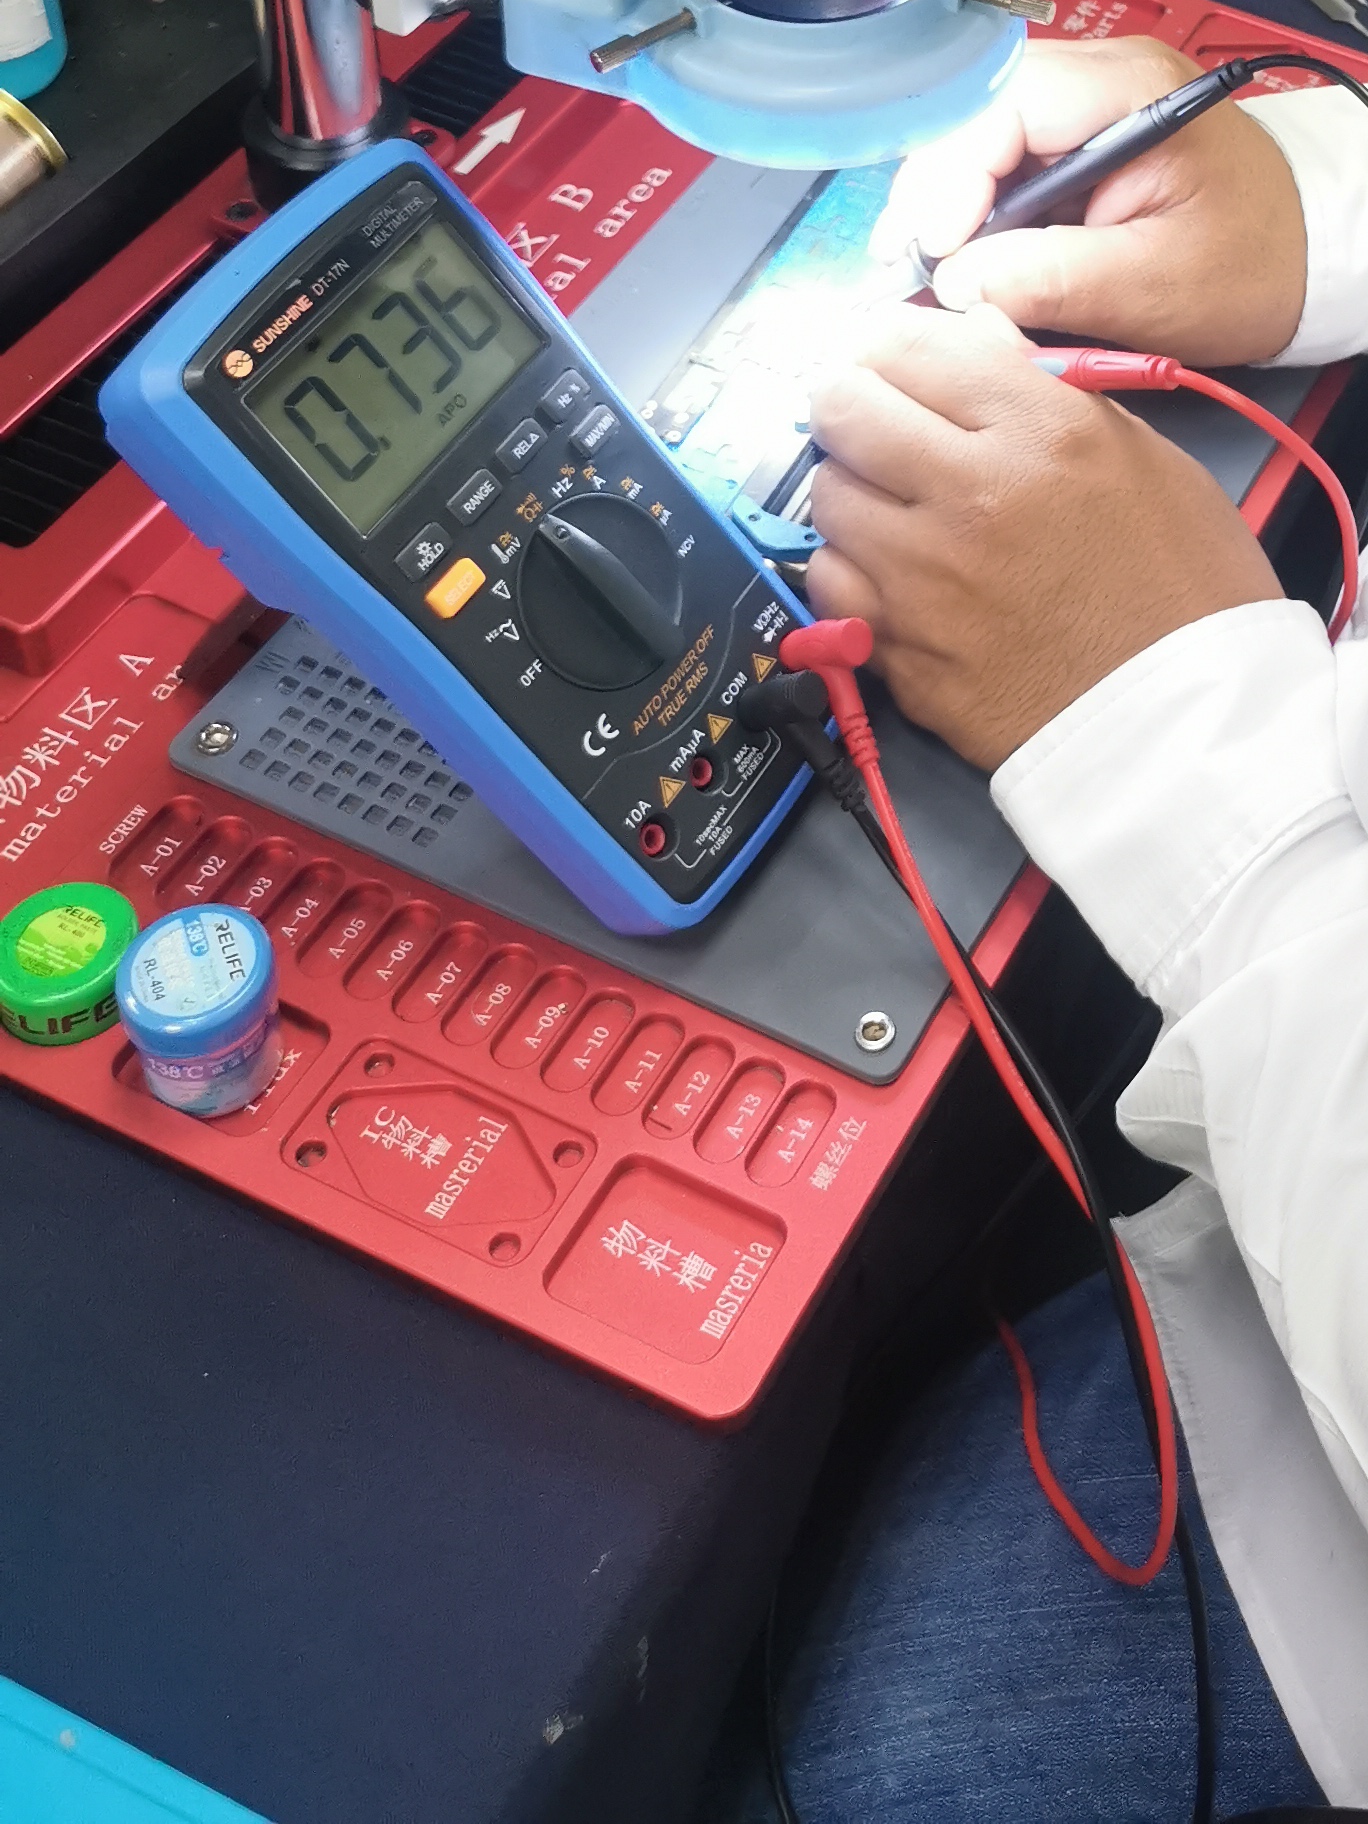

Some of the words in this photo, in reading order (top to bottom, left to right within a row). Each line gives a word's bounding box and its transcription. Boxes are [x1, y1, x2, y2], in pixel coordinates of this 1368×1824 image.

[547, 183, 594, 213] B
[593, 167, 673, 238] area
[361, 202, 398, 237] DIGITAL
[368, 196, 425, 250] MULTIMETER
[252, 293, 314, 354] SUNSHINE
[310, 258, 351, 297] DT-17N
[283, 256, 501, 482] 0.736
[437, 393, 468, 427] APO
[462, 479, 496, 514] RANGE
[551, 477, 575, 498] Hz
[592, 475, 607, 490] A
[627, 482, 644, 500] mA
[417, 542, 445, 572] HOLD
[505, 537, 522, 559] mV
[678, 534, 697, 558] NCV
[444, 570, 476, 606] SELECT
[485, 630, 500, 643] Hz
[118, 653, 156, 677] A
[520, 658, 545, 688] OFF
[631, 695, 664, 737] AUTO
[661, 648, 699, 697] POWER
[696, 623, 716, 654] OFF
[657, 693, 688, 728] TRUE
[684, 661, 710, 694] RMS
[721, 671, 749, 706] COM
[1, 716, 145, 863] material
[151, 664, 186, 702] ar
[733, 743, 751, 766] MAX
[741, 752, 766, 782] FUSED
[98, 803, 149, 856] SCREW
[624, 799, 652, 830] 10A
[707, 826, 723, 843] 10A
[140, 835, 184, 877] A-01
[708, 825, 734, 856] FUSED
[184, 854, 228, 896] A-02
[63, 904, 105, 929] RELIFE
[280, 897, 320, 939] A-04
[214, 918, 247, 982] RELIFE
[327, 917, 367, 960] A-05
[143, 957, 166, 1002] RL-404
[375, 939, 415, 982] A-06
[424, 961, 462, 1006] A-07
[474, 982, 512, 1027] A-08
[0, 994, 119, 1036] ELIFE
[524, 1004, 563, 1049] A-09
[572, 1026, 610, 1071] A-10
[624, 1049, 662, 1094] A-11
[672, 1070, 711, 1117] A-12
[725, 1092, 763, 1140] A-13
[776, 1117, 814, 1164] A-14
[808, 1116, 868, 1191] 螺丝位
[424, 1115, 509, 1220] masrerial
[600, 1219, 718, 1294] 物料槽
[699, 1241, 774, 1340] masreria
